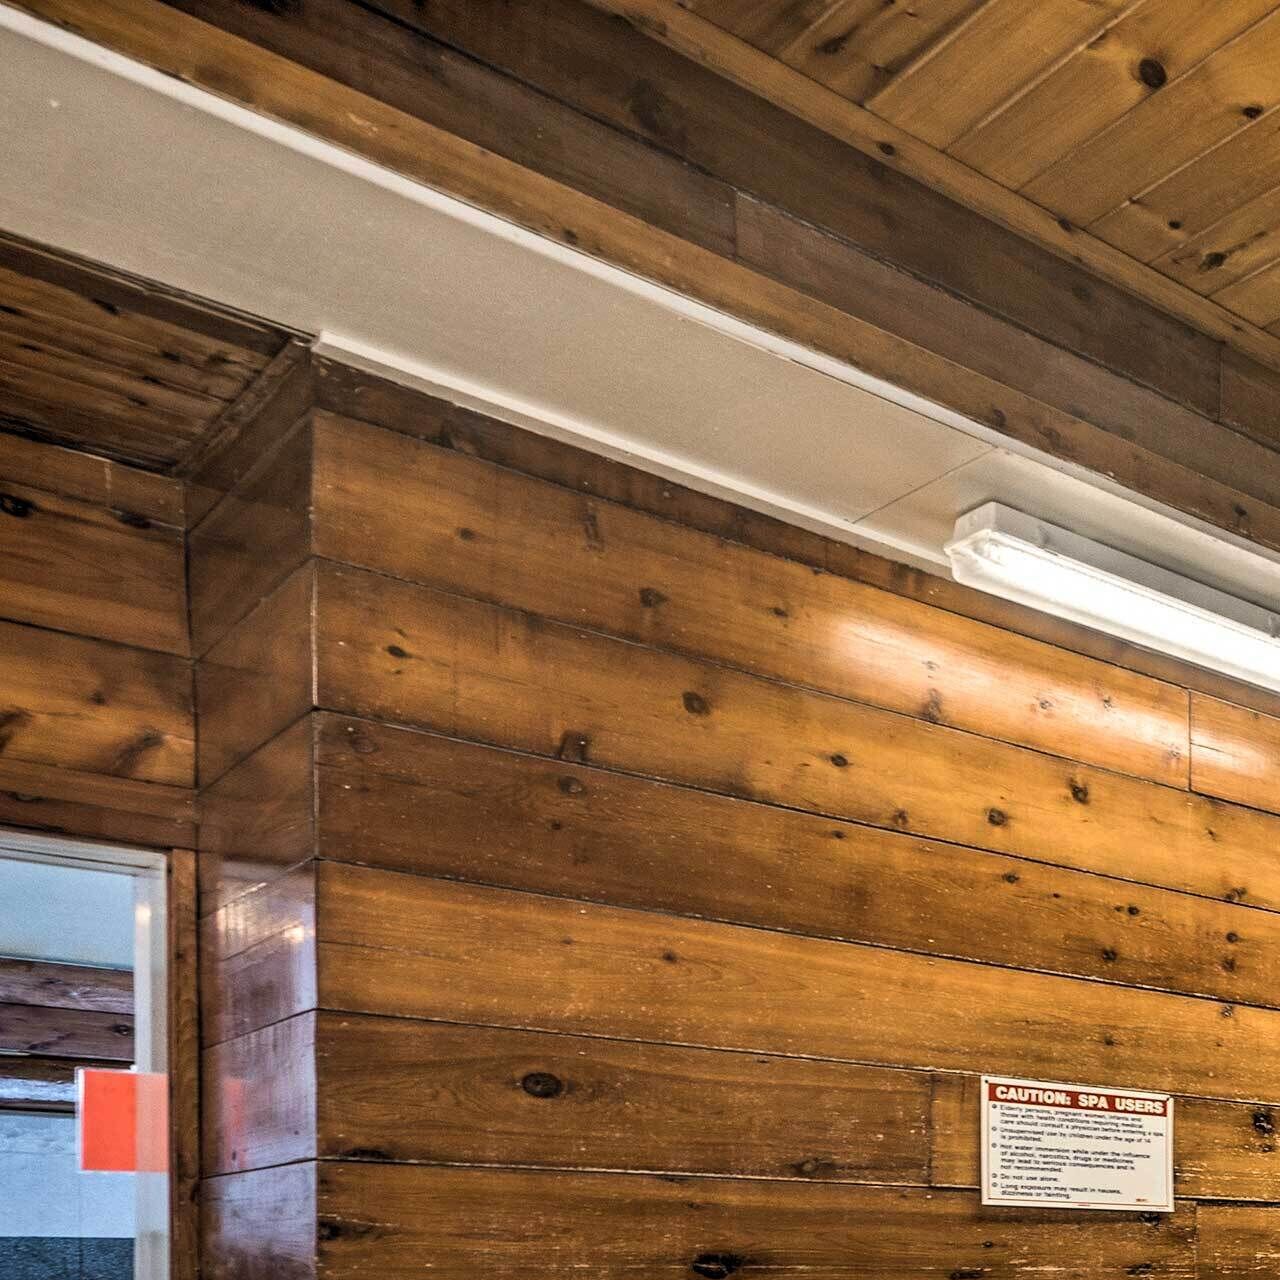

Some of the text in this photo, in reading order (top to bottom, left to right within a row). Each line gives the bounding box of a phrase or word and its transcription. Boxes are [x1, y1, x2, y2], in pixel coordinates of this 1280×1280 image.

[995, 1086, 1164, 1113] CAUTION: SPA USERS
